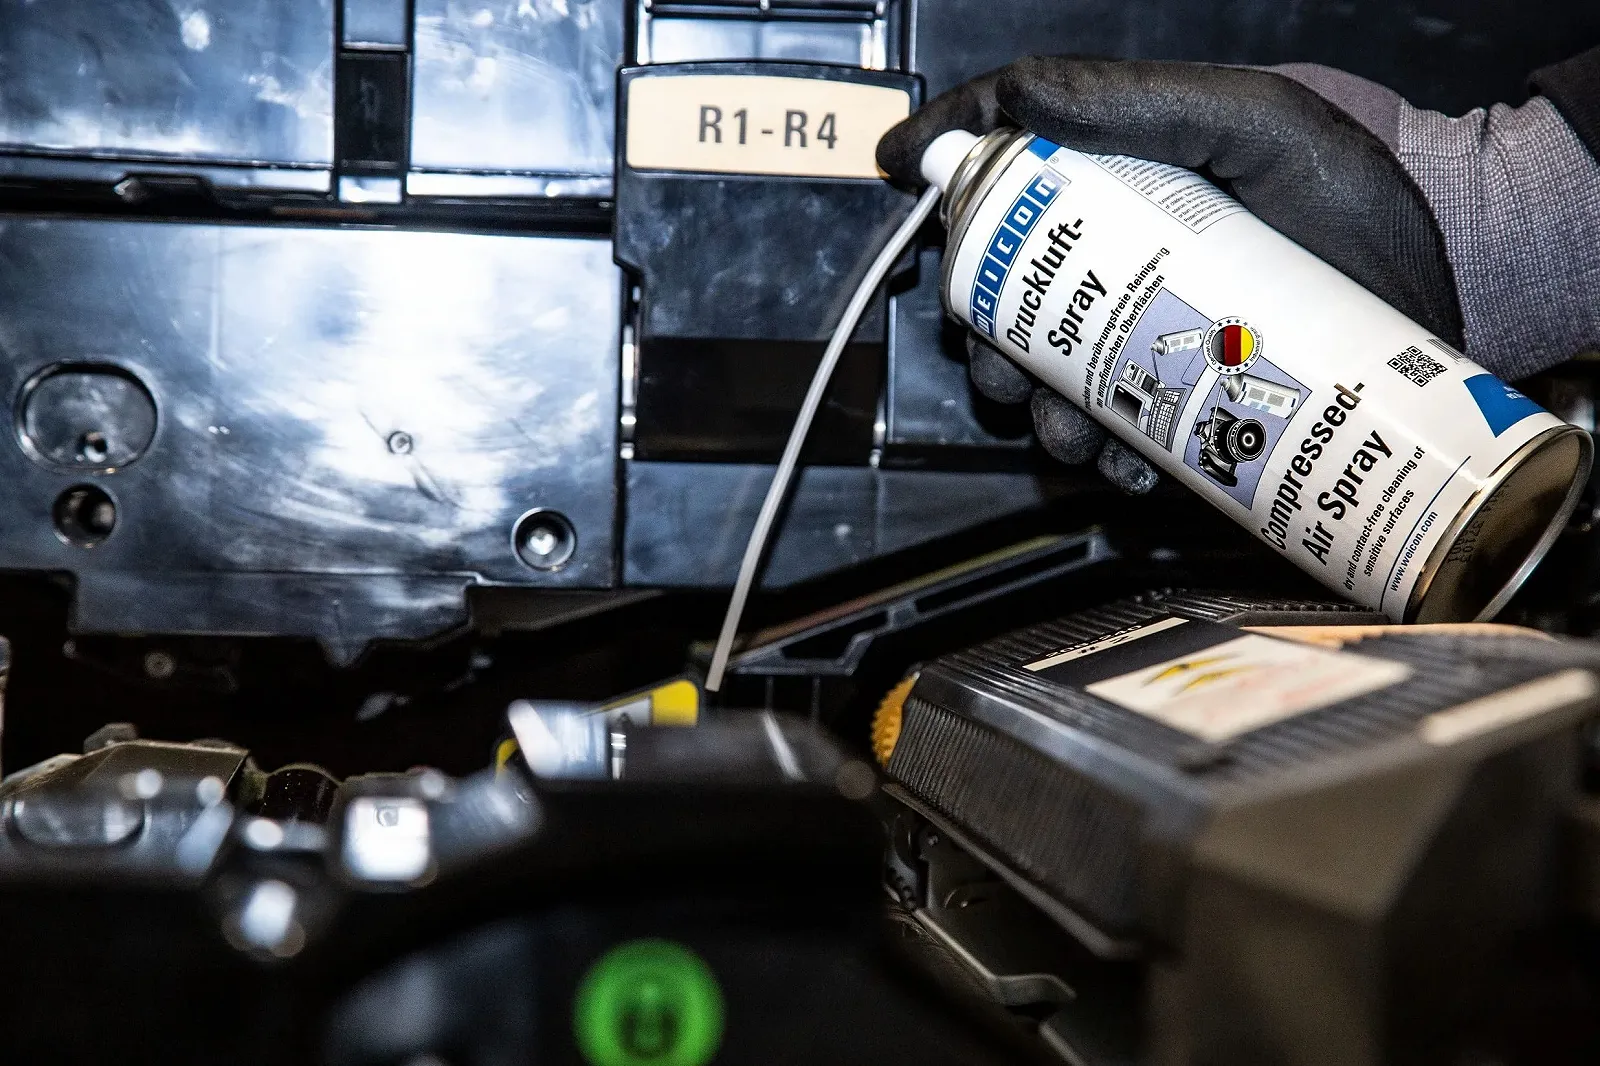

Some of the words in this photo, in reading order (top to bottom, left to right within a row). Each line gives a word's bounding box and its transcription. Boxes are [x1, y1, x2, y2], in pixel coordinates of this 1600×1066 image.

[698, 104, 838, 149] R1-R4
[1007, 218, 1083, 353] Druckluft-
[1047, 269, 1107, 356] Spray
[1126, 247, 1170, 293] Reinigung
[1088, 293, 1131, 370] berührungsfreie
[1097, 334, 1125, 398] empfindlichen
[1119, 274, 1165, 335] Oberflächen
[1085, 368, 1095, 387] und
[1261, 382, 1365, 550] Compressed-
[1317, 429, 1393, 521] Spray
[1302, 520, 1335, 566] Air
[1344, 560, 1357, 576] and
[1351, 503, 1385, 563] contact-free
[1382, 459, 1418, 503] cleaning
[1413, 446, 1426, 460] of
[1363, 535, 1387, 577] sensitive
[1382, 489, 1415, 535] surfaces
[1390, 511, 1438, 592] www.weicon.com
